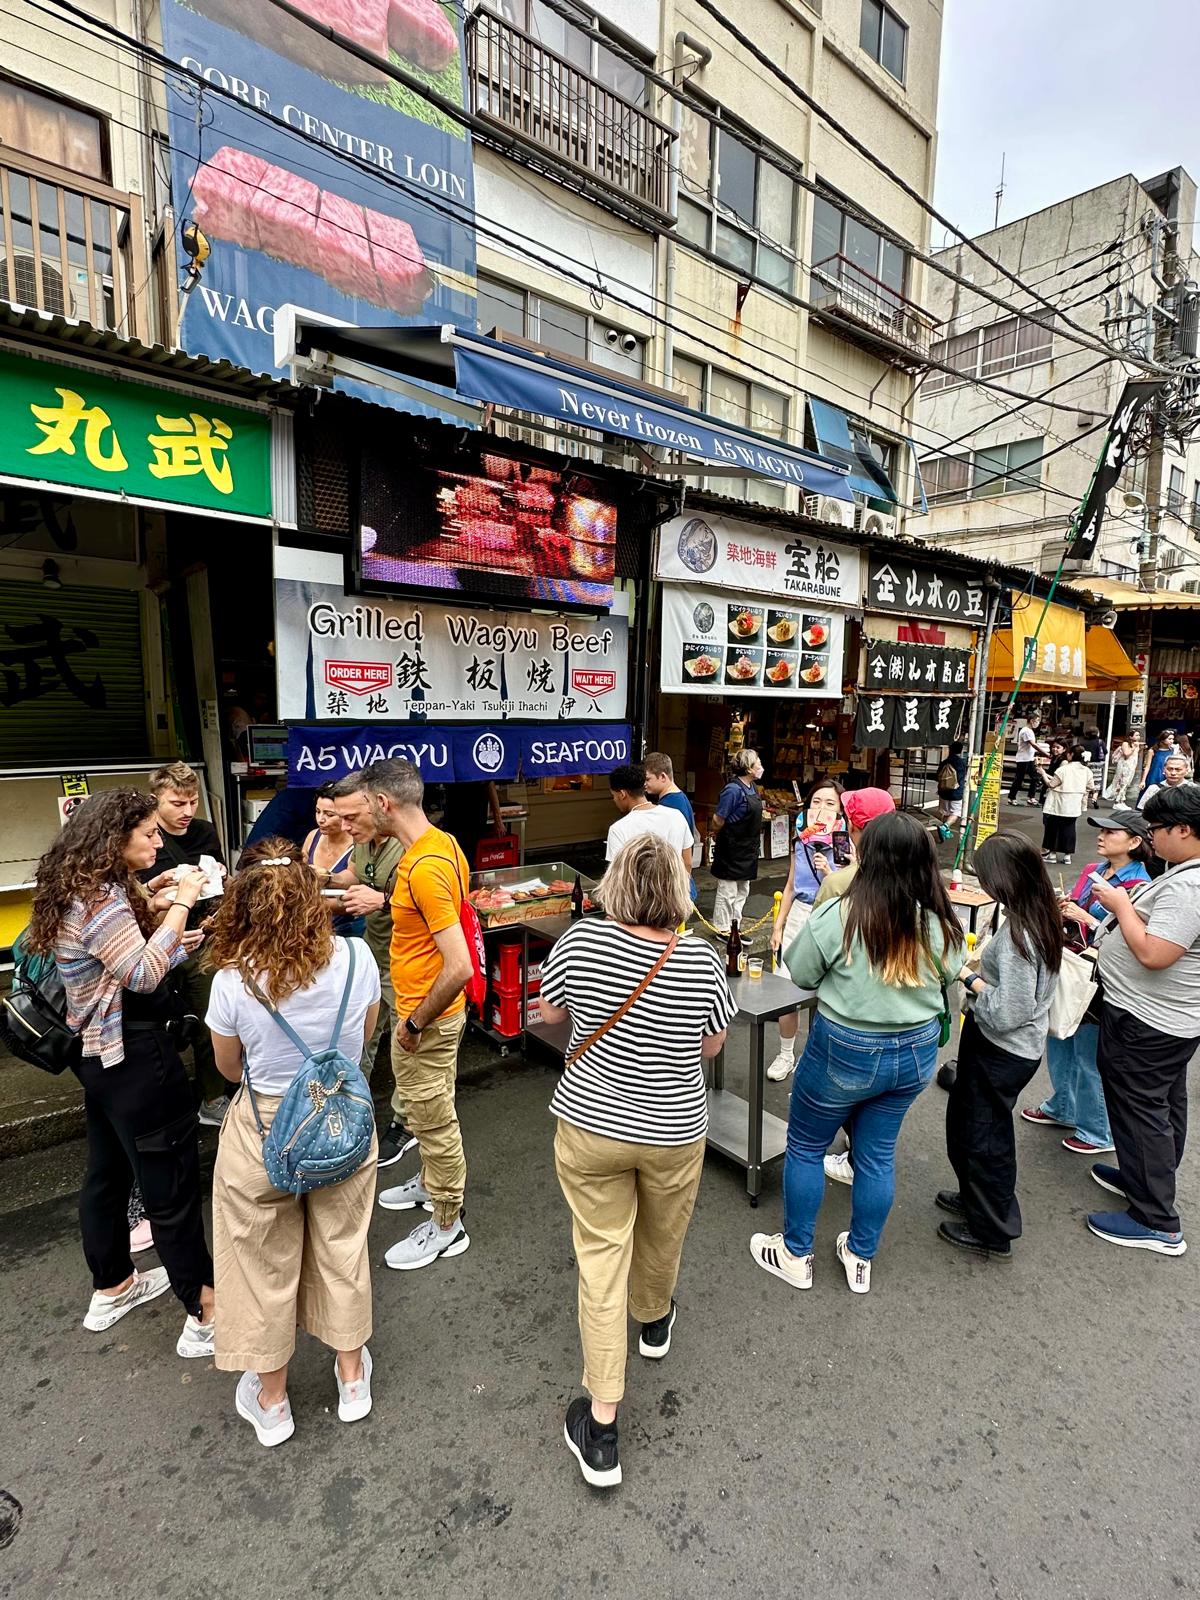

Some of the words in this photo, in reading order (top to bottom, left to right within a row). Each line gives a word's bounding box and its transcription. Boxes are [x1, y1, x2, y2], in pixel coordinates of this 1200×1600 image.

[180, 56, 271, 115] CORE
[282, 104, 395, 173] CENTER
[404, 154, 466, 200] LOIN
[25, 387, 234, 494] 丸武
[558, 388, 630, 430] Never
[635, 412, 703, 450] frozen
[737, 446, 805, 483] WAGYU
[726, 542, 777, 569] 築地海鮮
[784, 539, 840, 584] 宝船
[784, 578, 841, 597] TAKARABUNE
[310, 604, 423, 641] Grilled
[446, 616, 537, 653] Wagyu
[551, 626, 612, 654] Beef
[330, 667, 362, 679] ORDER
[364, 668, 388, 680] HERE
[575, 676, 593, 684] WAIT
[594, 676, 613, 685] HERE
[403, 700, 475, 712] Teppan-Yaki
[482, 700, 514, 713] Tsukiji
[518, 700, 548, 711] Ihachi
[297, 745, 337, 771] A5
[531, 740, 627, 764] SEAFOOD
